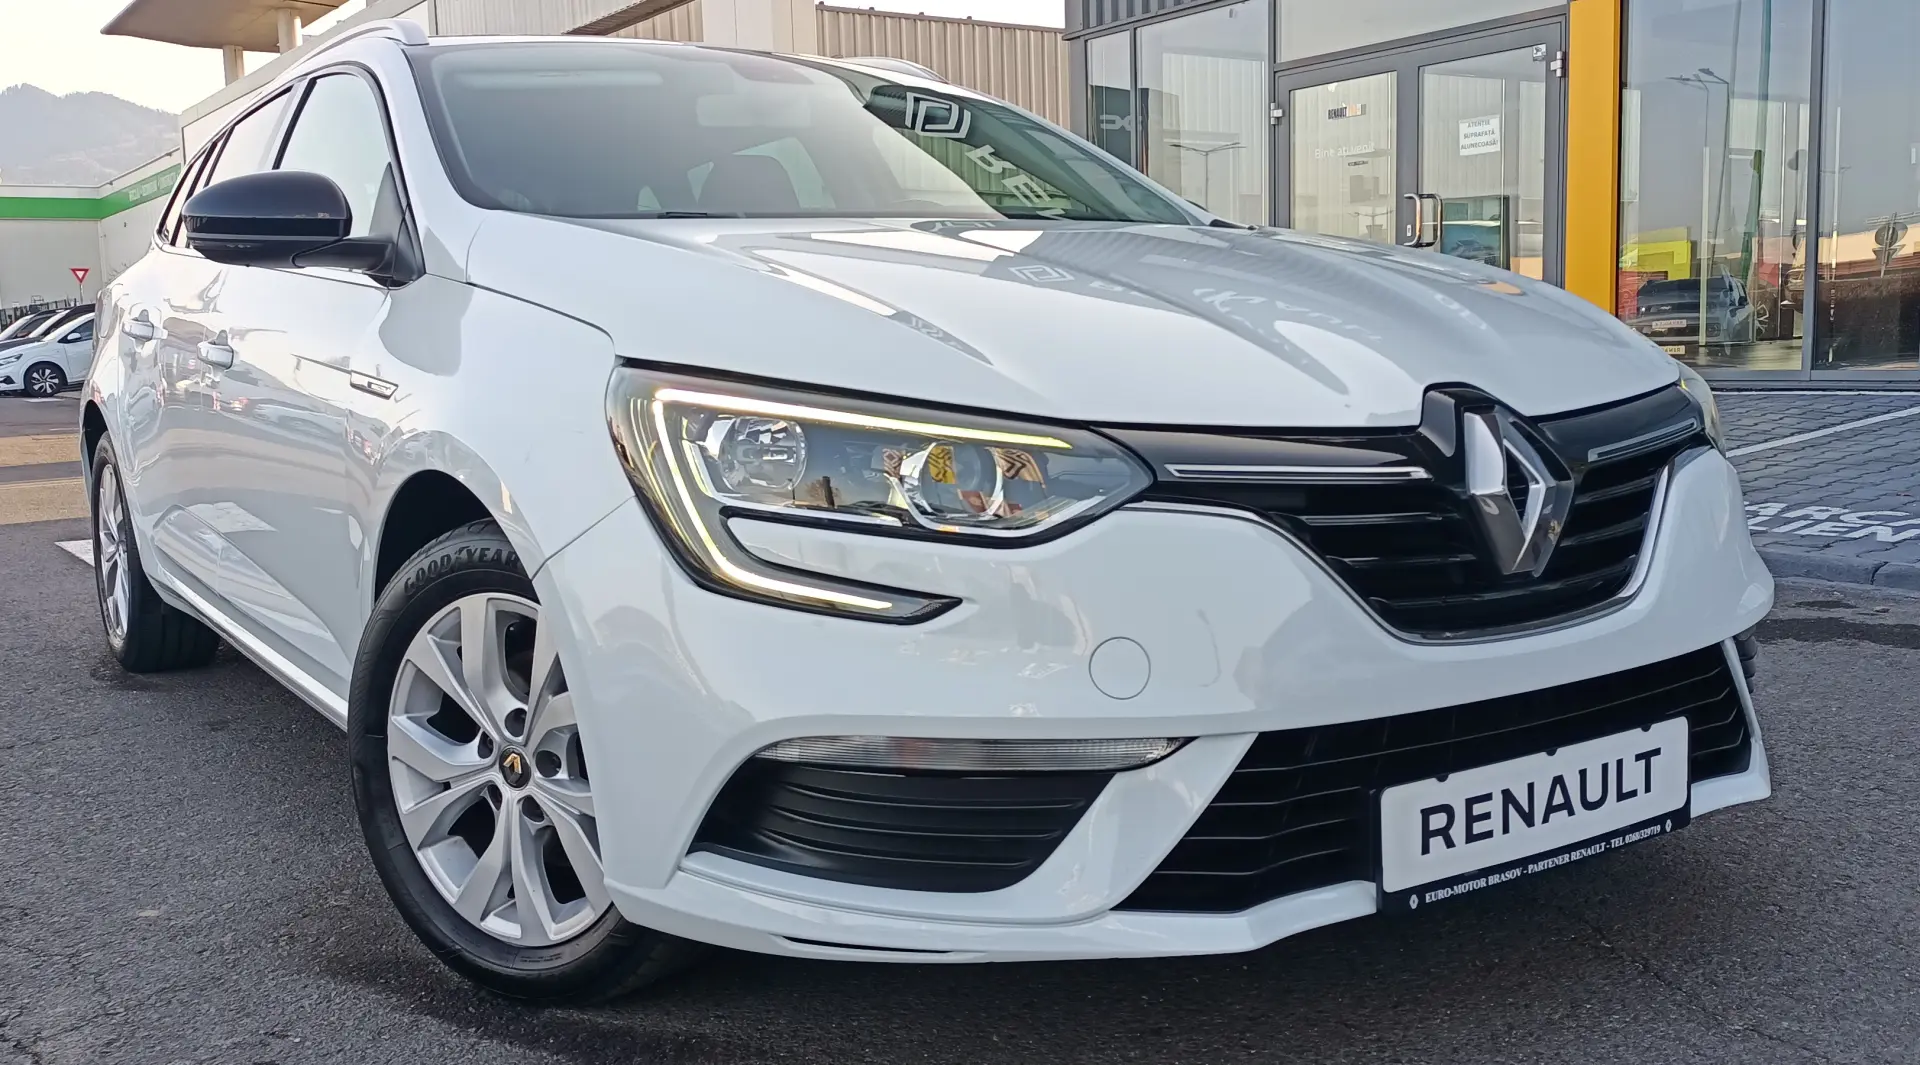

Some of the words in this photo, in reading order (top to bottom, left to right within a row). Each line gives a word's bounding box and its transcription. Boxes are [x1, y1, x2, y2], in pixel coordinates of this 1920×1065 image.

[403, 545, 522, 596] GOODYEAR
[1420, 747, 1662, 856] RENAULT
[1425, 877, 1487, 903] EURO-MOTOR
[1488, 867, 1523, 886] BRASOV
[1528, 853, 1571, 874] PARTENER
[1571, 841, 1606, 862] RENAULT
